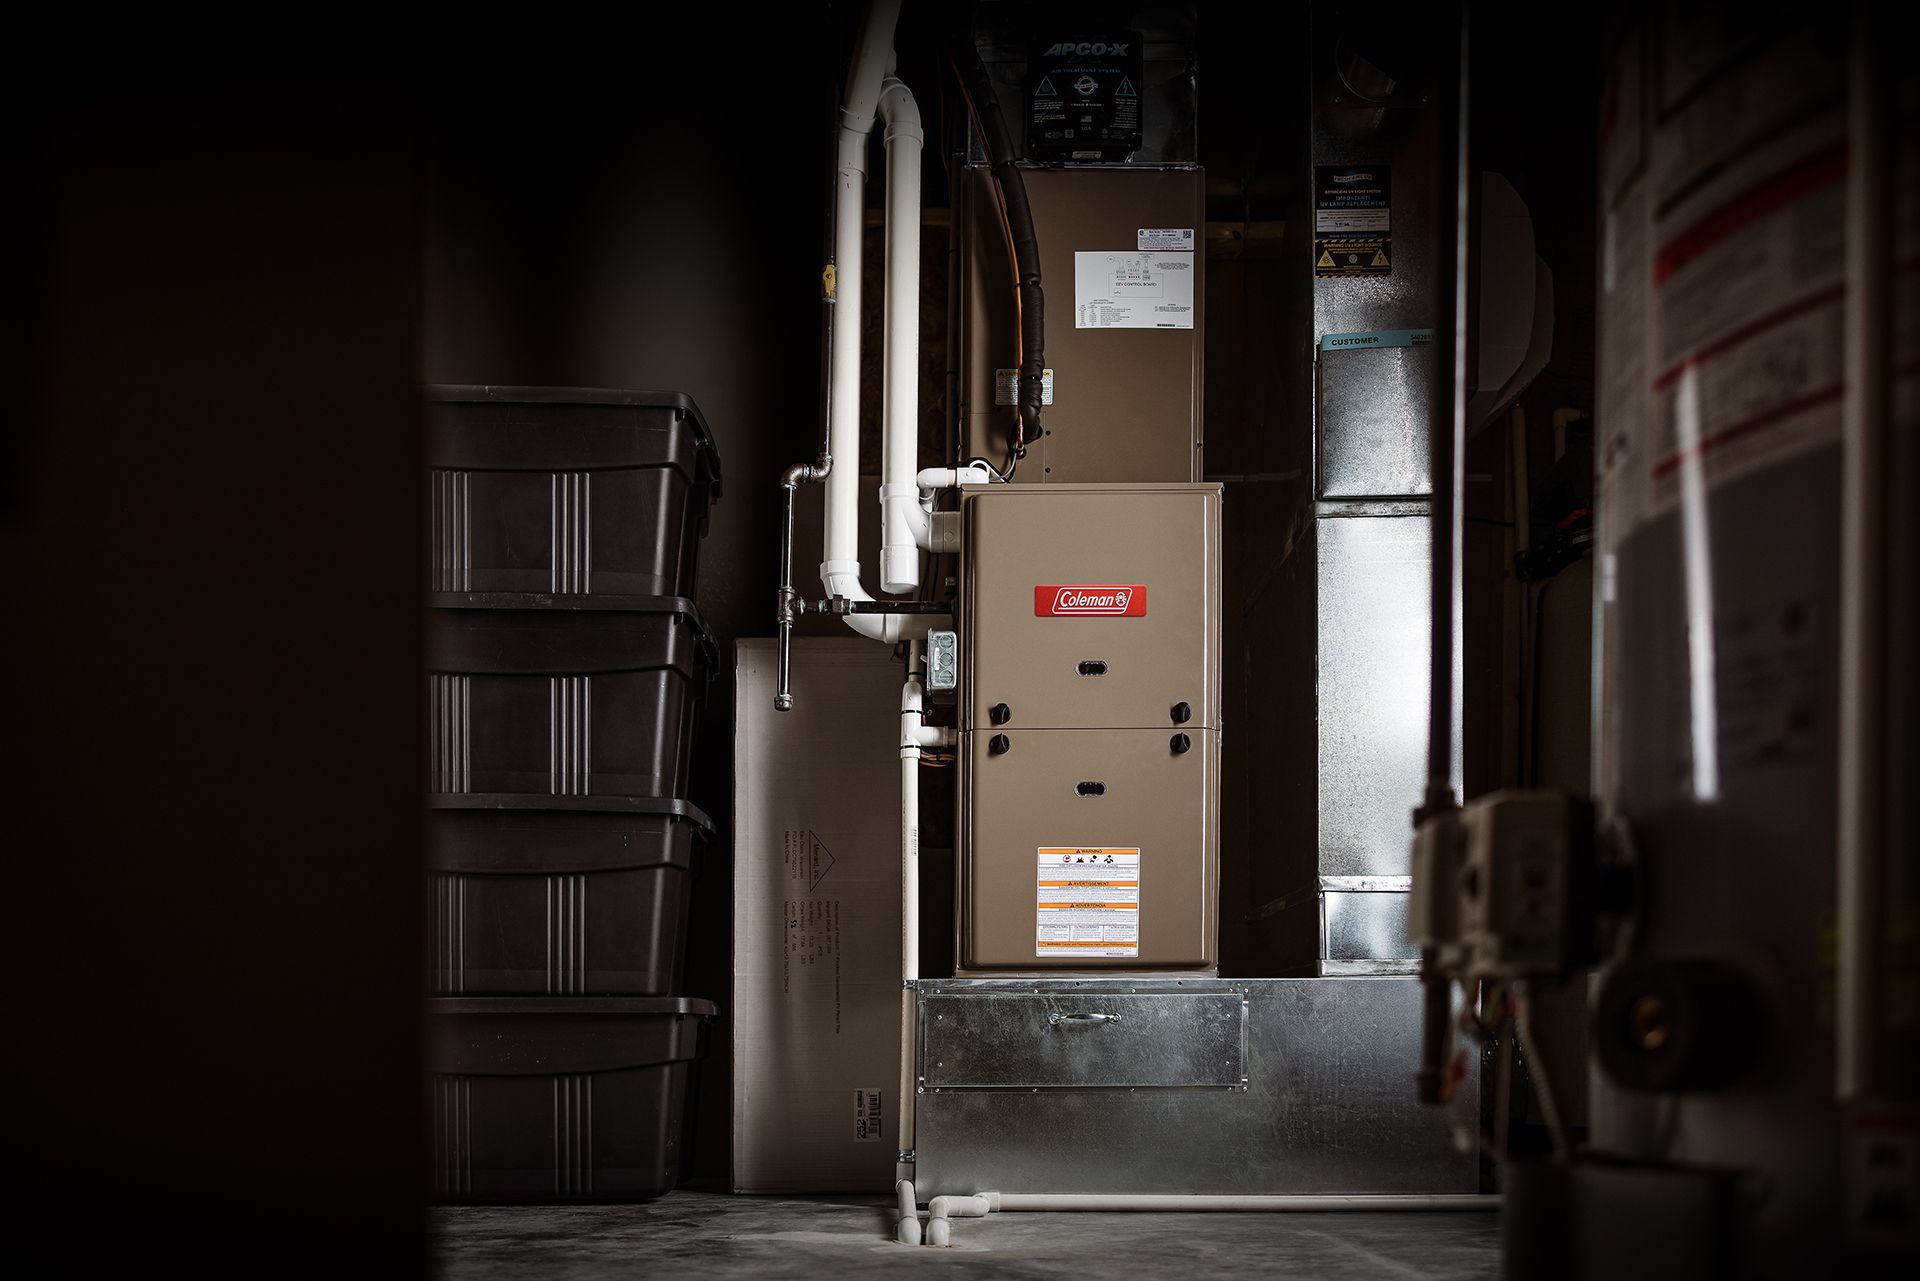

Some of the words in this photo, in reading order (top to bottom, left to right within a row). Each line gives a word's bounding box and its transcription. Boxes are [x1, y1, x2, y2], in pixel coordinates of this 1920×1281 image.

[1041, 42, 1129, 57] APCO-X
[1331, 336, 1380, 346] CUSTOMER
[1060, 591, 1114, 607] Coleman
[856, 1119, 866, 1139] 252
